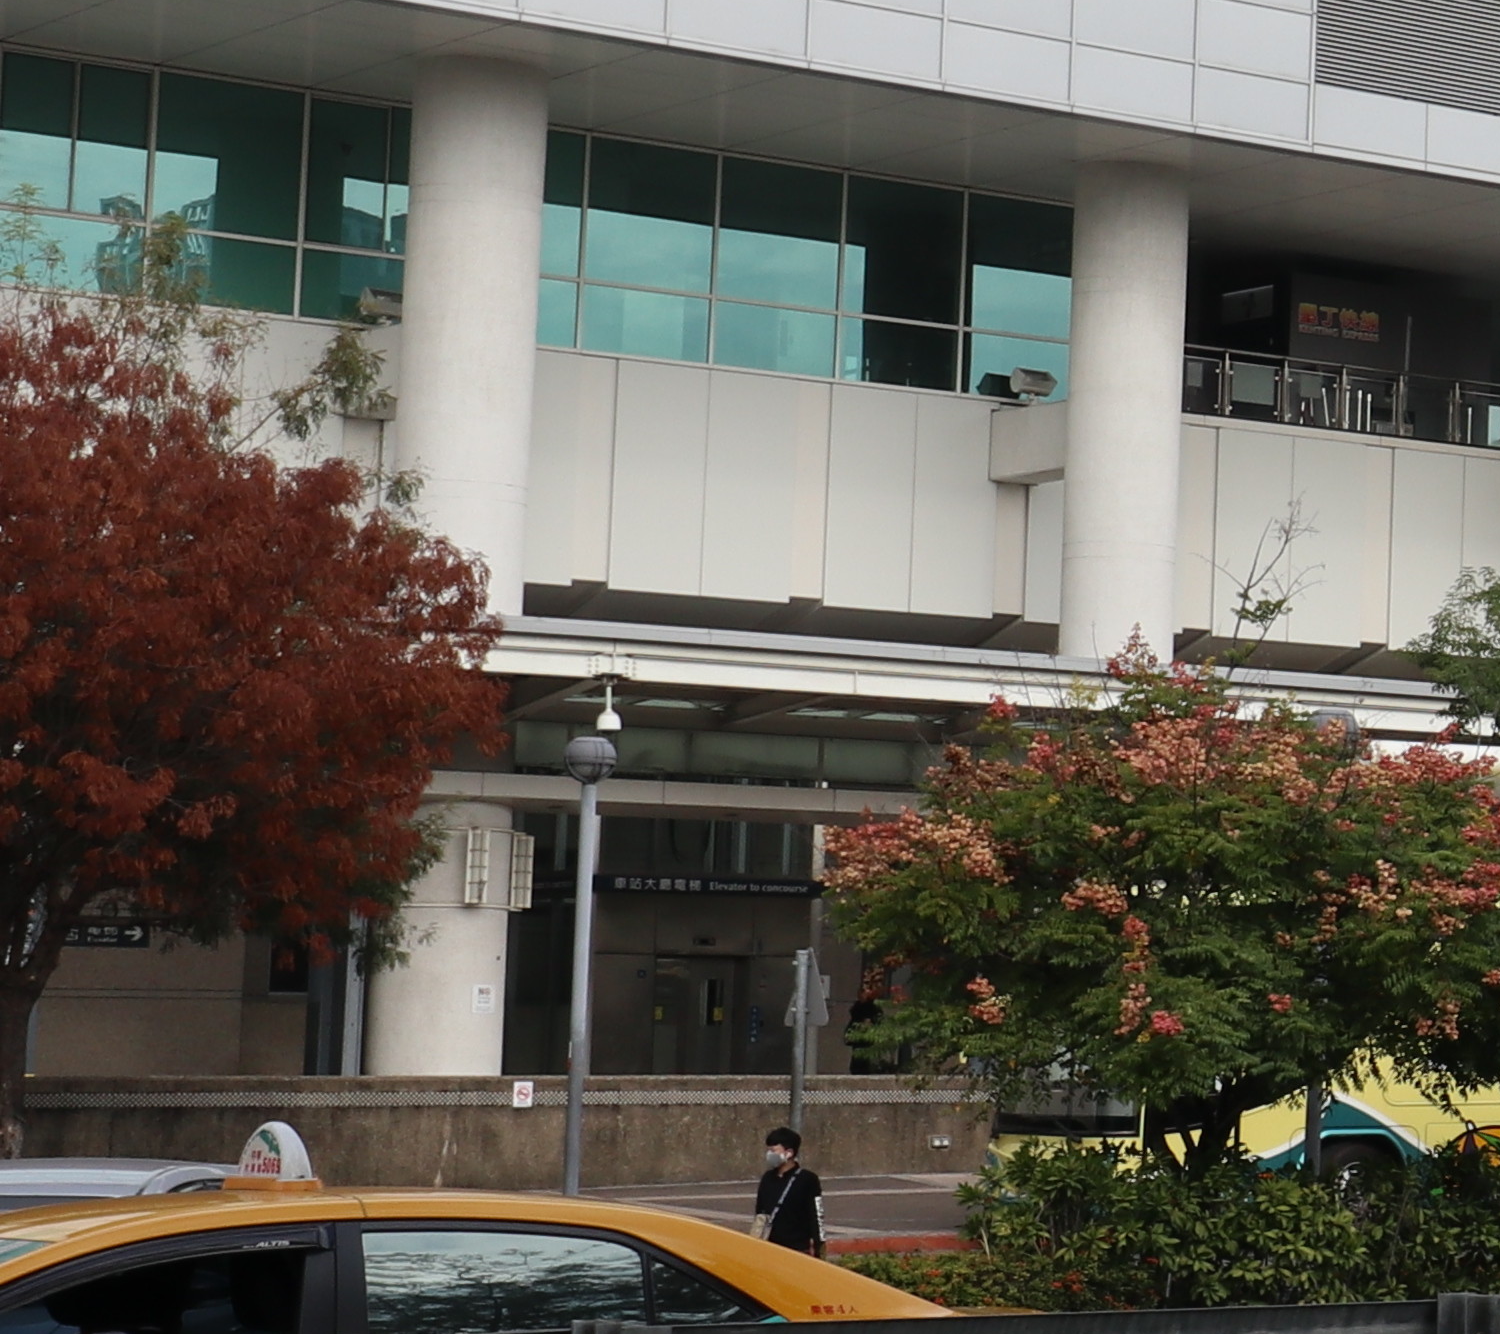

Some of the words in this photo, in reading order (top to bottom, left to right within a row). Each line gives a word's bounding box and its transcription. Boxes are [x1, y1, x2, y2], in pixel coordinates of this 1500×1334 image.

[709, 880, 748, 892] Elevator
[750, 881, 760, 892] to
[762, 883, 809, 894] concourse
[255, 1240, 290, 1248] ALTIS
